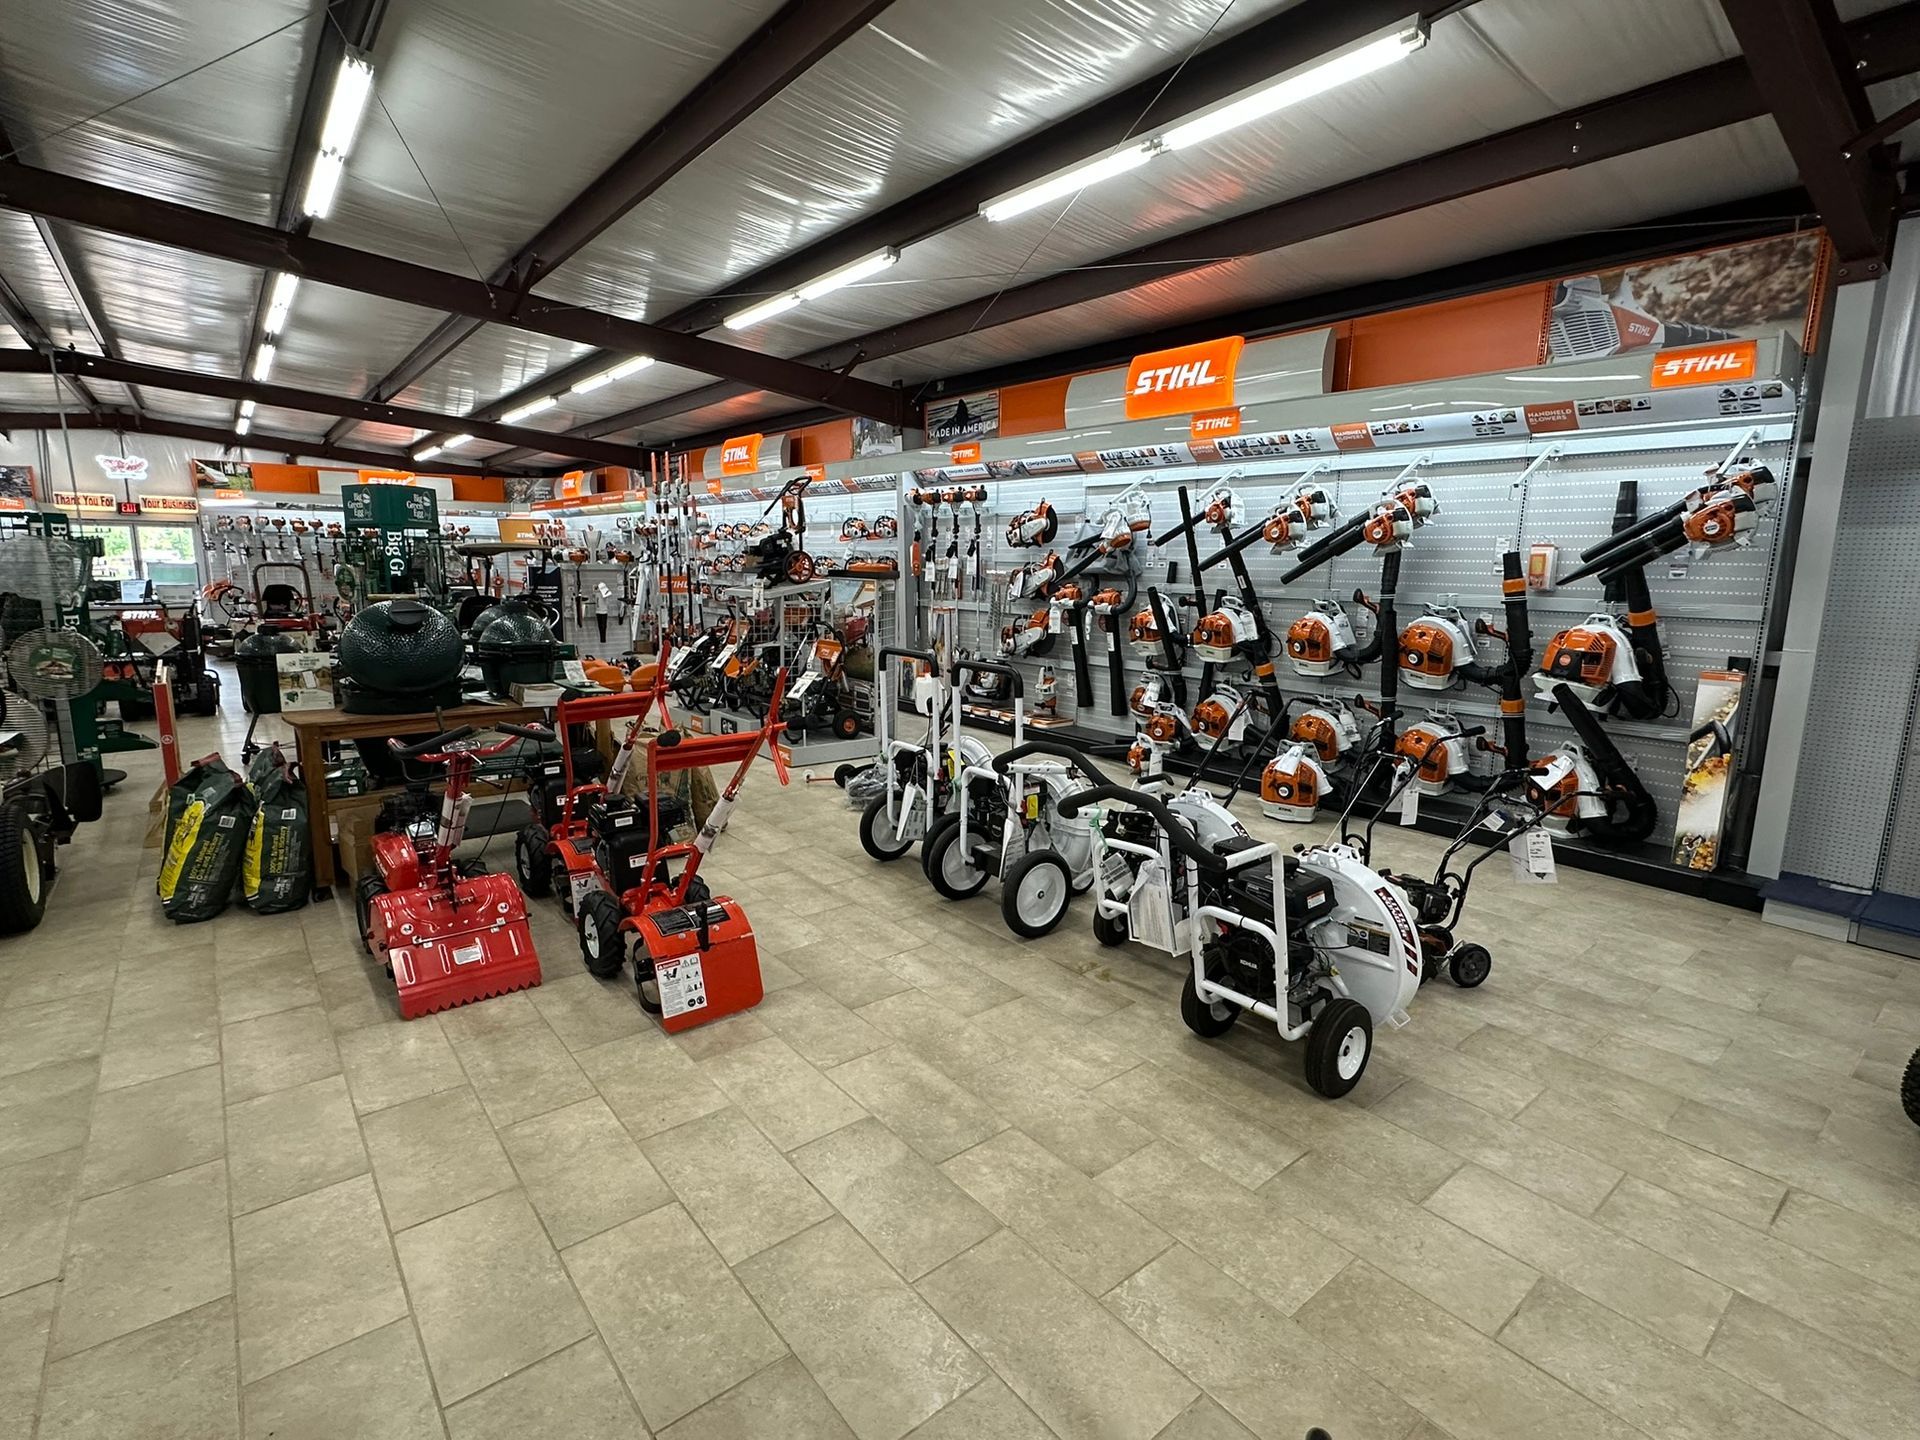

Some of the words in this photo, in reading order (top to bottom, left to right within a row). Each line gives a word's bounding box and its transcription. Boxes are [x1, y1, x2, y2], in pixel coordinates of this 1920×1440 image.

[1627, 322, 1650, 336] STIHL
[1661, 352, 1742, 376] STIHL
[1134, 360, 1216, 395] STIHL
[1527, 408, 1572, 419] HANDHELD
[1529, 415, 1567, 423] BLOWERS
[929, 428, 950, 439] MADE
[951, 426, 960, 435] IN
[962, 420, 997, 434] AMERICA
[1195, 416, 1232, 431] STIHL
[723, 445, 749, 462] STIHL
[952, 449, 975, 459] STIHL
[83, 495, 98, 506] You
[101, 496, 114, 506] For
[141, 498, 160, 508] Your
[162, 499, 196, 510] Business
[406, 501, 424, 510] Green
[385, 531, 403, 556] Big
[660, 580, 688, 589] SIHL
[122, 611, 160, 620] STIHL
[1378, 891, 1407, 937] WONDER
[1387, 896, 1411, 931] LITTLE
